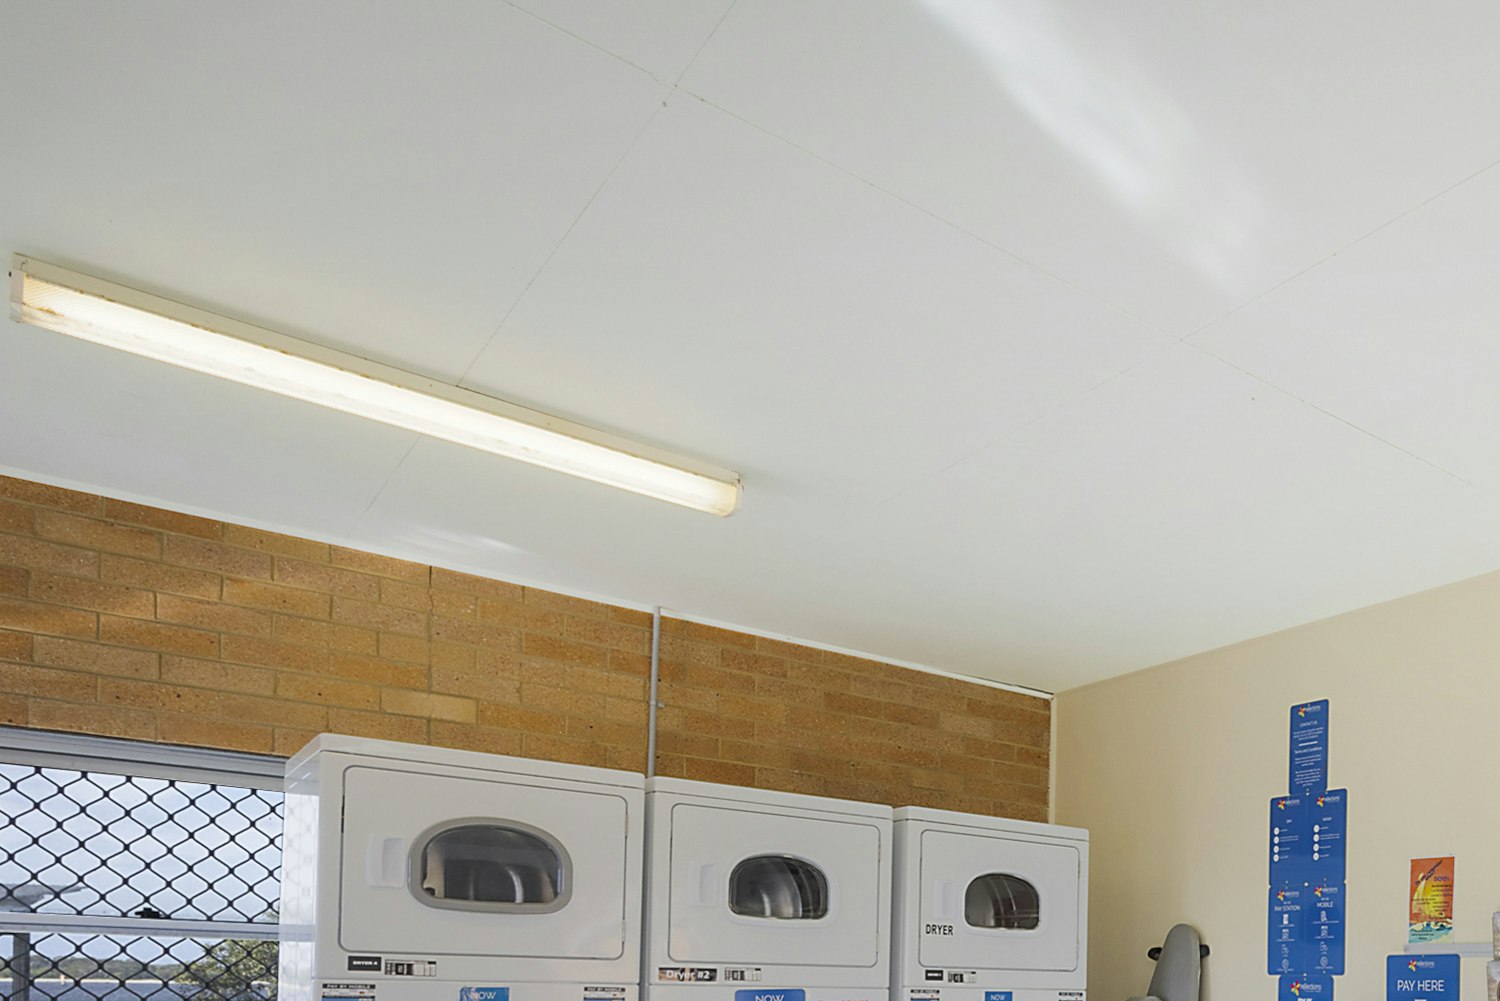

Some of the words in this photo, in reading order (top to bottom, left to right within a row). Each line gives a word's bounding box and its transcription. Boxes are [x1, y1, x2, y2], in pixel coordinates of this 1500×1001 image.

[925, 923, 954, 936] DRYER
[666, 970, 695, 981] Dryer
[698, 970, 710, 979] #2
[1397, 980, 1416, 991] PAY
[1418, 980, 1444, 991] HERE
